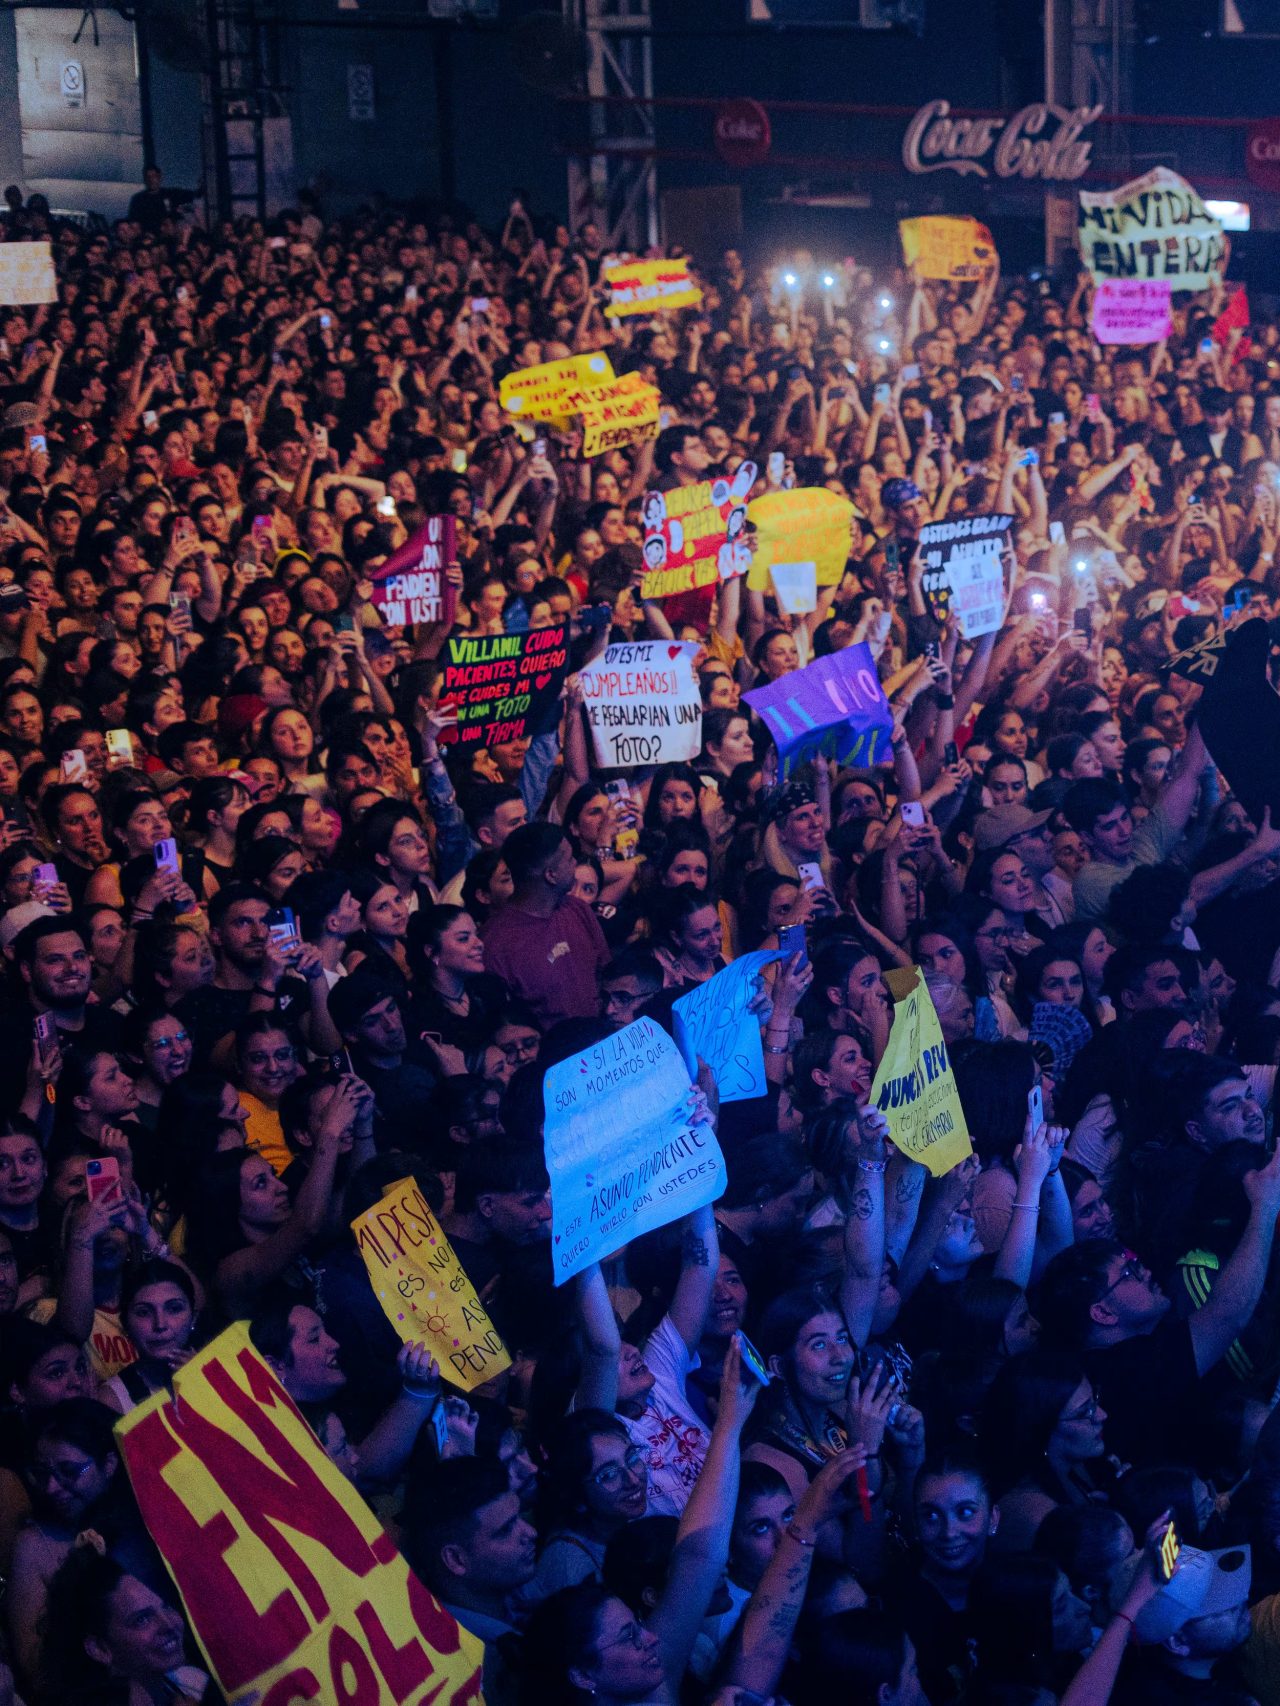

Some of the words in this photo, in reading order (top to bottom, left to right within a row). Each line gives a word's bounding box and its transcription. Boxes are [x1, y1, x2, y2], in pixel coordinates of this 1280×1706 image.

[450, 637, 521, 663] VILLAMIL
[525, 628, 563, 652] CUIDO
[635, 645, 654, 662] MI
[520, 649, 566, 675] QUIERO
[469, 683, 510, 702] CUIDES
[514, 681, 530, 695] MI
[469, 704, 490, 718] UNA
[494, 695, 530, 720] FOTO
[675, 702, 702, 724] UNA
[462, 726, 482, 741] UNA
[485, 719, 525, 746] FIRMA
[610, 732, 662, 765] FOTO?
[594, 1050, 607, 1070] SI
[615, 1041, 627, 1066] LA
[628, 1026, 648, 1050] VIDA
[555, 1087, 577, 1112] SON
[586, 1056, 644, 1096] MOMENTOS
[565, 1215, 582, 1237] ESTE
[590, 1172, 633, 1224] ASUNTO
[637, 1129, 706, 1191] PENDIENTE
[560, 1235, 590, 1268] QUIERO
[632, 1193, 653, 1212] CON
[397, 1273, 425, 1298] es
